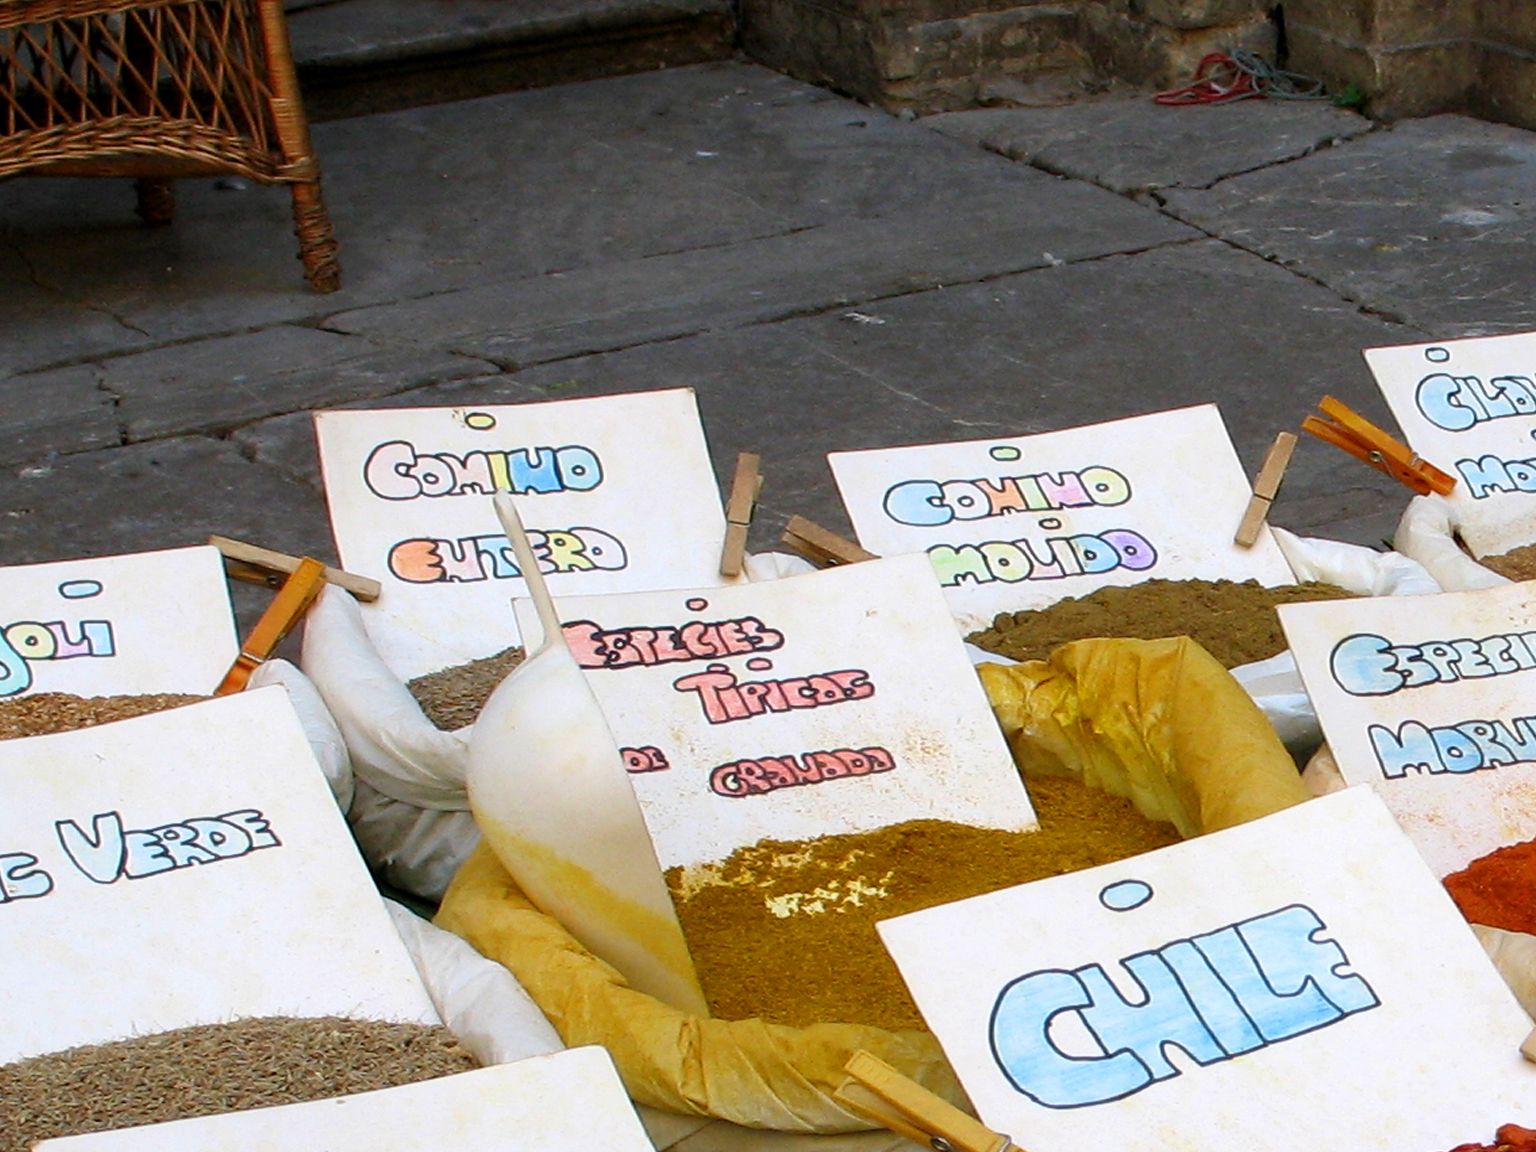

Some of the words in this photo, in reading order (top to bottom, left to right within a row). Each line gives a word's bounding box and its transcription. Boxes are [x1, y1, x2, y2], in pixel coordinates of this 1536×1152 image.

[364, 412, 603, 500] COMINO
[883, 446, 1132, 526] COMINO
[926, 518, 1158, 587] MOLIDO
[710, 747, 895, 797] GRANADA
[55, 809, 282, 884] VERDE
[989, 879, 1381, 1109] CHILE
